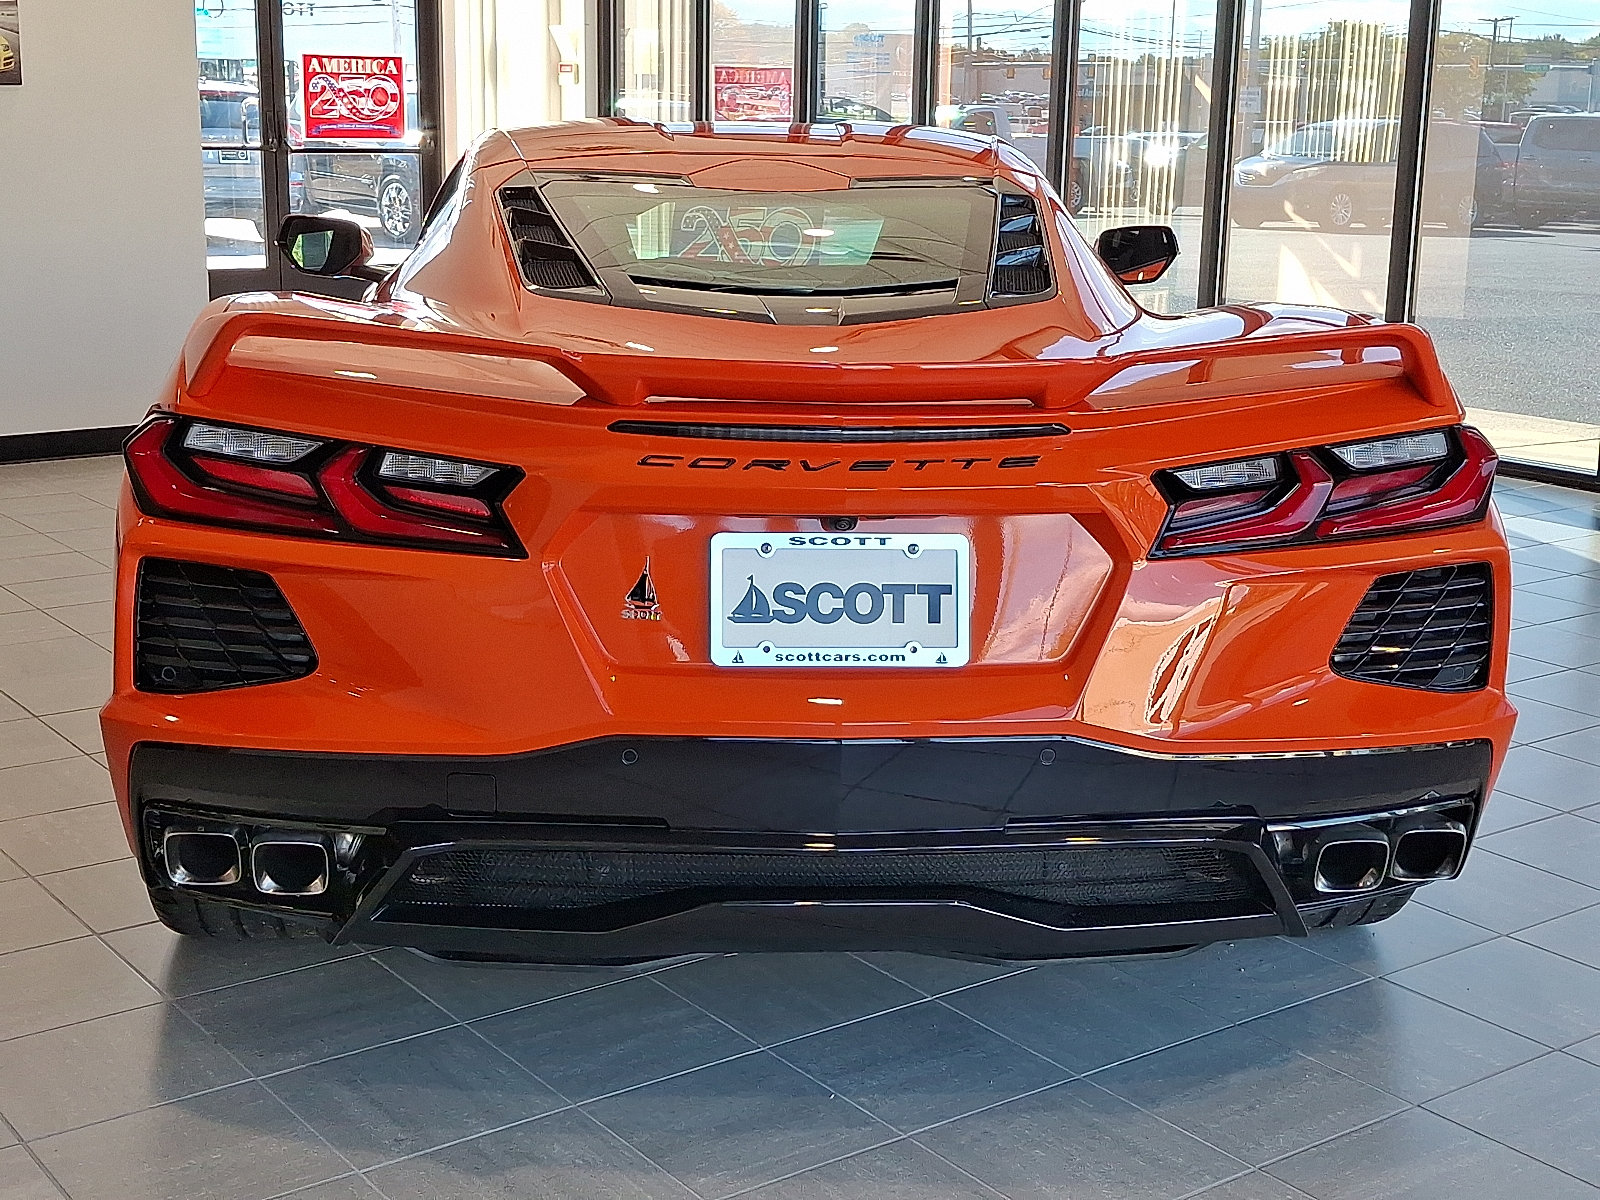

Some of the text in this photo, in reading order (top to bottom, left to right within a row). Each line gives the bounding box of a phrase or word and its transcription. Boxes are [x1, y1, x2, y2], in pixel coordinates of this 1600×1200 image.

[308, 57, 399, 75] AMERICA
[308, 74, 400, 123] 250
[678, 205, 816, 266] 250
[637, 454, 1042, 472] CORVETTE
[788, 536, 893, 546] SCOTT
[772, 581, 953, 625] SCOTT
[775, 652, 906, 663] scottcars.com
